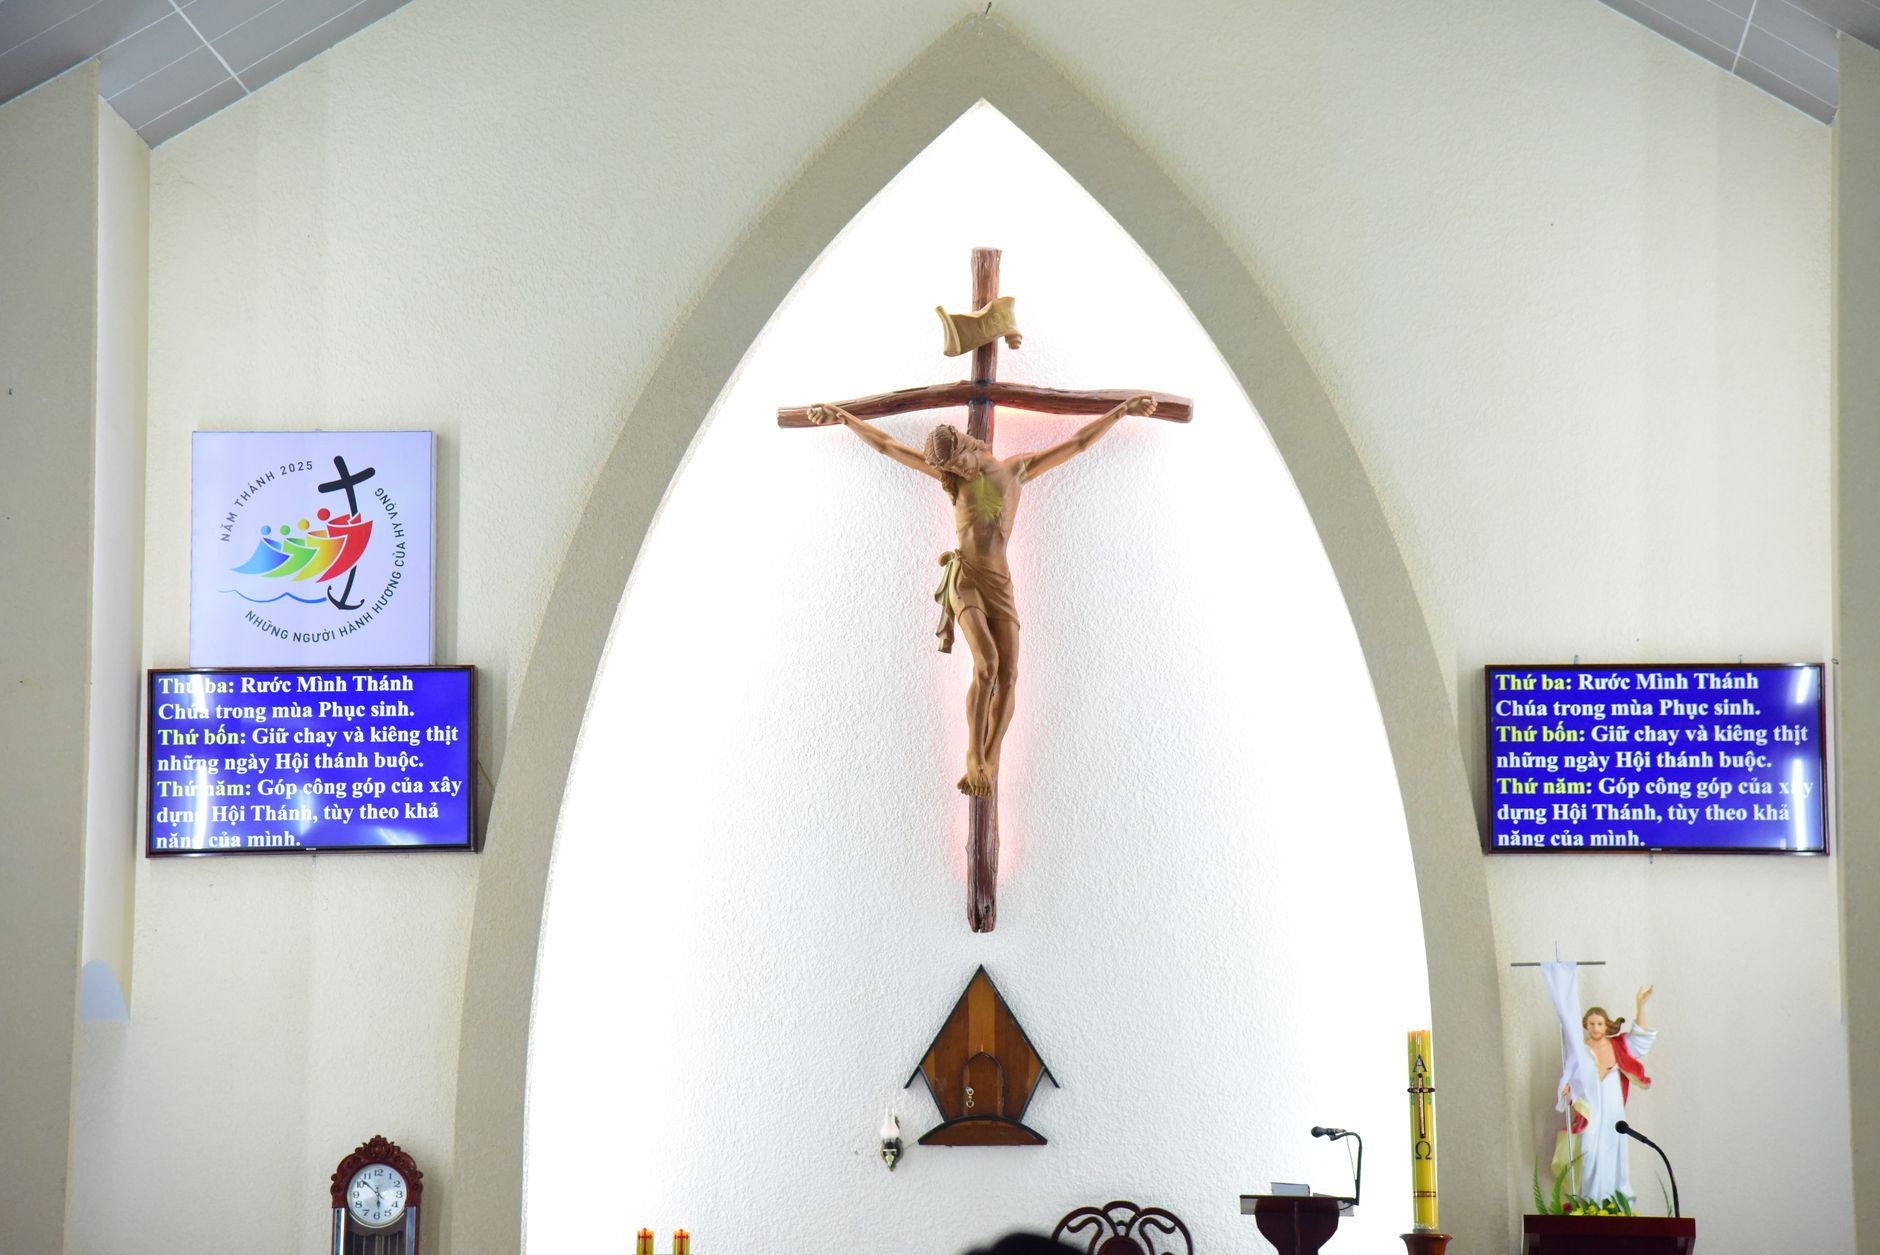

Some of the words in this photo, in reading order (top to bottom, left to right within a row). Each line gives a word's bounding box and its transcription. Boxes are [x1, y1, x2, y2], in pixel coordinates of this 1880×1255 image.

[220, 512, 237, 541] NĂM
[234, 471, 275, 507] THÁNH
[280, 460, 313, 475] 2025
[374, 488, 398, 520] VỌNG
[392, 522, 405, 538] HY
[392, 541, 406, 567] CỦA
[372, 571, 402, 614] HƯƠNG
[245, 610, 288, 640] NHỮNG
[339, 612, 373, 637] HÀNH
[293, 628, 335, 643] NGƯỜI
[204, 676, 234, 694] ba:
[240, 675, 291, 693] Rước
[297, 673, 347, 692] Mình
[353, 675, 413, 692] Thánh
[1496, 674, 1537, 691] Thứ
[1542, 673, 1572, 691] ba:
[1578, 673, 1630, 690] Rước
[1635, 673, 1689, 690] Mình
[1694, 673, 1759, 690] Thánh
[215, 705, 266, 722] trong
[272, 704, 313, 718] mùa
[319, 702, 365, 720] Phục
[371, 701, 415, 717] sinh.
[1496, 700, 1547, 717] Chúa
[1554, 702, 1606, 719] trong
[1611, 700, 1653, 716] mùa
[1659, 699, 1708, 719] Phục
[1714, 699, 1760, 716] sinh.
[158, 728, 202, 746] Thứ
[204, 724, 246, 745] bốn:
[252, 728, 289, 745] Giữ
[294, 728, 336, 746] chay
[342, 728, 364, 744] và
[370, 726, 421, 745] kiêng
[426, 726, 458, 745] thịt
[1496, 726, 1537, 742] Thứ
[1542, 721, 1585, 742] bốn:
[1591, 725, 1628, 742] Giữ
[1634, 726, 1678, 745] chay
[1685, 726, 1709, 741] và
[1714, 725, 1767, 746] kiêng
[1773, 726, 1808, 746] thịt
[157, 753, 219, 774] những
[225, 754, 268, 774] ngày
[275, 752, 308, 771] Hội
[314, 752, 368, 768] thánh
[374, 751, 424, 770] buộc.
[1497, 752, 1558, 771] những
[1564, 753, 1610, 772] ngày
[1616, 751, 1651, 771] Hội
[1657, 751, 1713, 768] thánh
[1719, 752, 1772, 771] buộc.
[257, 779, 298, 798] Góp
[303, 779, 347, 798] công
[352, 779, 385, 797] góp
[391, 776, 423, 793] của
[428, 778, 462, 795] xây
[1497, 778, 1538, 794] Thứ
[1543, 778, 1592, 794] năm:
[1599, 778, 1640, 798] Góp
[1645, 778, 1691, 798] công
[1697, 778, 1732, 797] góp
[1738, 778, 1772, 794] của
[1779, 780, 1813, 798] xy
[156, 805, 207, 825] dựn
[212, 804, 245, 823] Hội
[250, 804, 318, 823] Thánh,
[324, 806, 352, 823] tùy
[359, 804, 398, 819] theo
[405, 802, 438, 819] khả
[1497, 806, 1547, 823] dựng
[1552, 804, 1587, 823] Hội
[1592, 804, 1662, 823] Thánh,
[1668, 806, 1698, 824] tùy
[1705, 804, 1748, 820] theo
[1754, 804, 1789, 820] khả
[156, 831, 205, 849] năn
[208, 830, 241, 847] của
[247, 830, 301, 846] mình.
[1498, 831, 1544, 847] năng
[1550, 830, 1585, 846] của
[1591, 829, 1645, 846] mình.
[373, 1212, 380, 1220] 6
